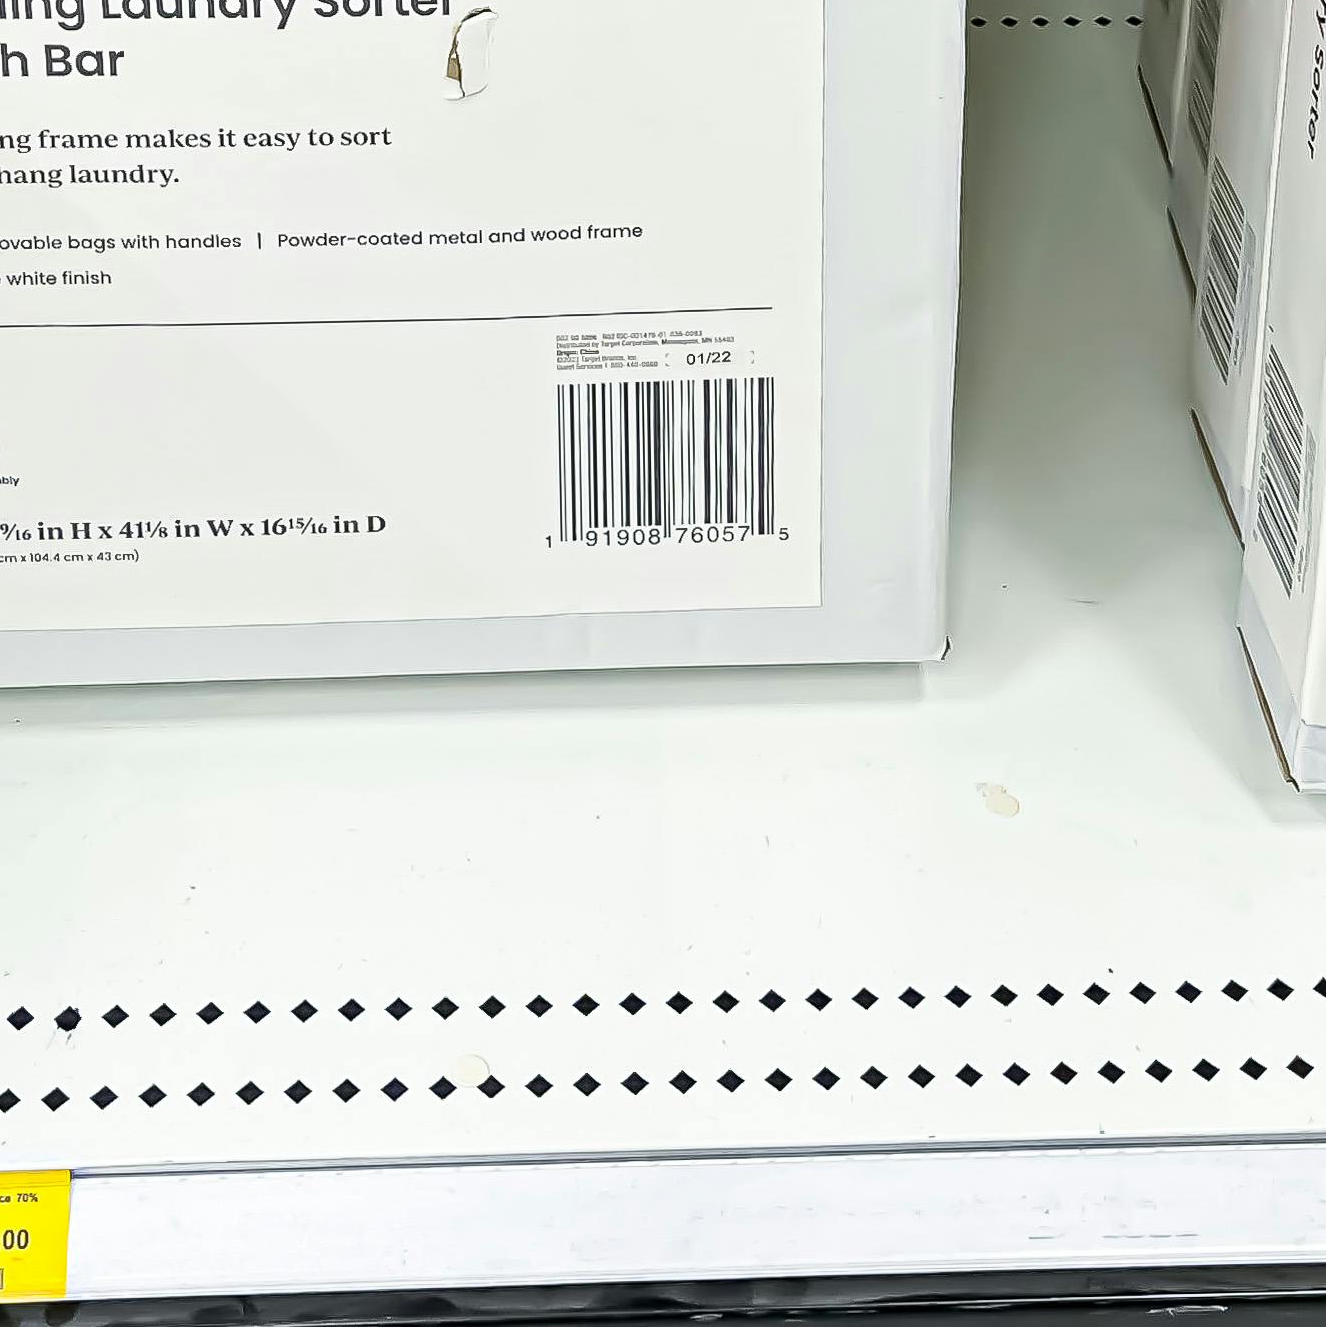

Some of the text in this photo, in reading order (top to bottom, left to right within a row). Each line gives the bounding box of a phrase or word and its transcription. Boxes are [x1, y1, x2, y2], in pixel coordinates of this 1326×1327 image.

[44, 44, 125, 77] Bar
[1307, 44, 1324, 160] Sorter
[37, 129, 119, 149] frame
[125, 129, 212, 148] makes
[217, 128, 237, 148] it
[243, 132, 301, 152] easy
[307, 128, 334, 146] to
[340, 127, 392, 146] sort
[68, 164, 179, 188] laundry.
[67, 235, 116, 254] bags
[120, 234, 160, 250] with
[165, 233, 242, 249] handles
[278, 230, 423, 248] Powder-coated
[429, 229, 483, 245] metal
[488, 227, 525, 244] and
[530, 225, 581, 242] wood
[587, 224, 643, 240] frame
[5, 270, 57, 286] white
[62, 270, 112, 285] finish
[686, 350, 731, 366] 01/22
[586, 525, 750, 547] 91908 76057
[16, 1192, 39, 1204] 70%
